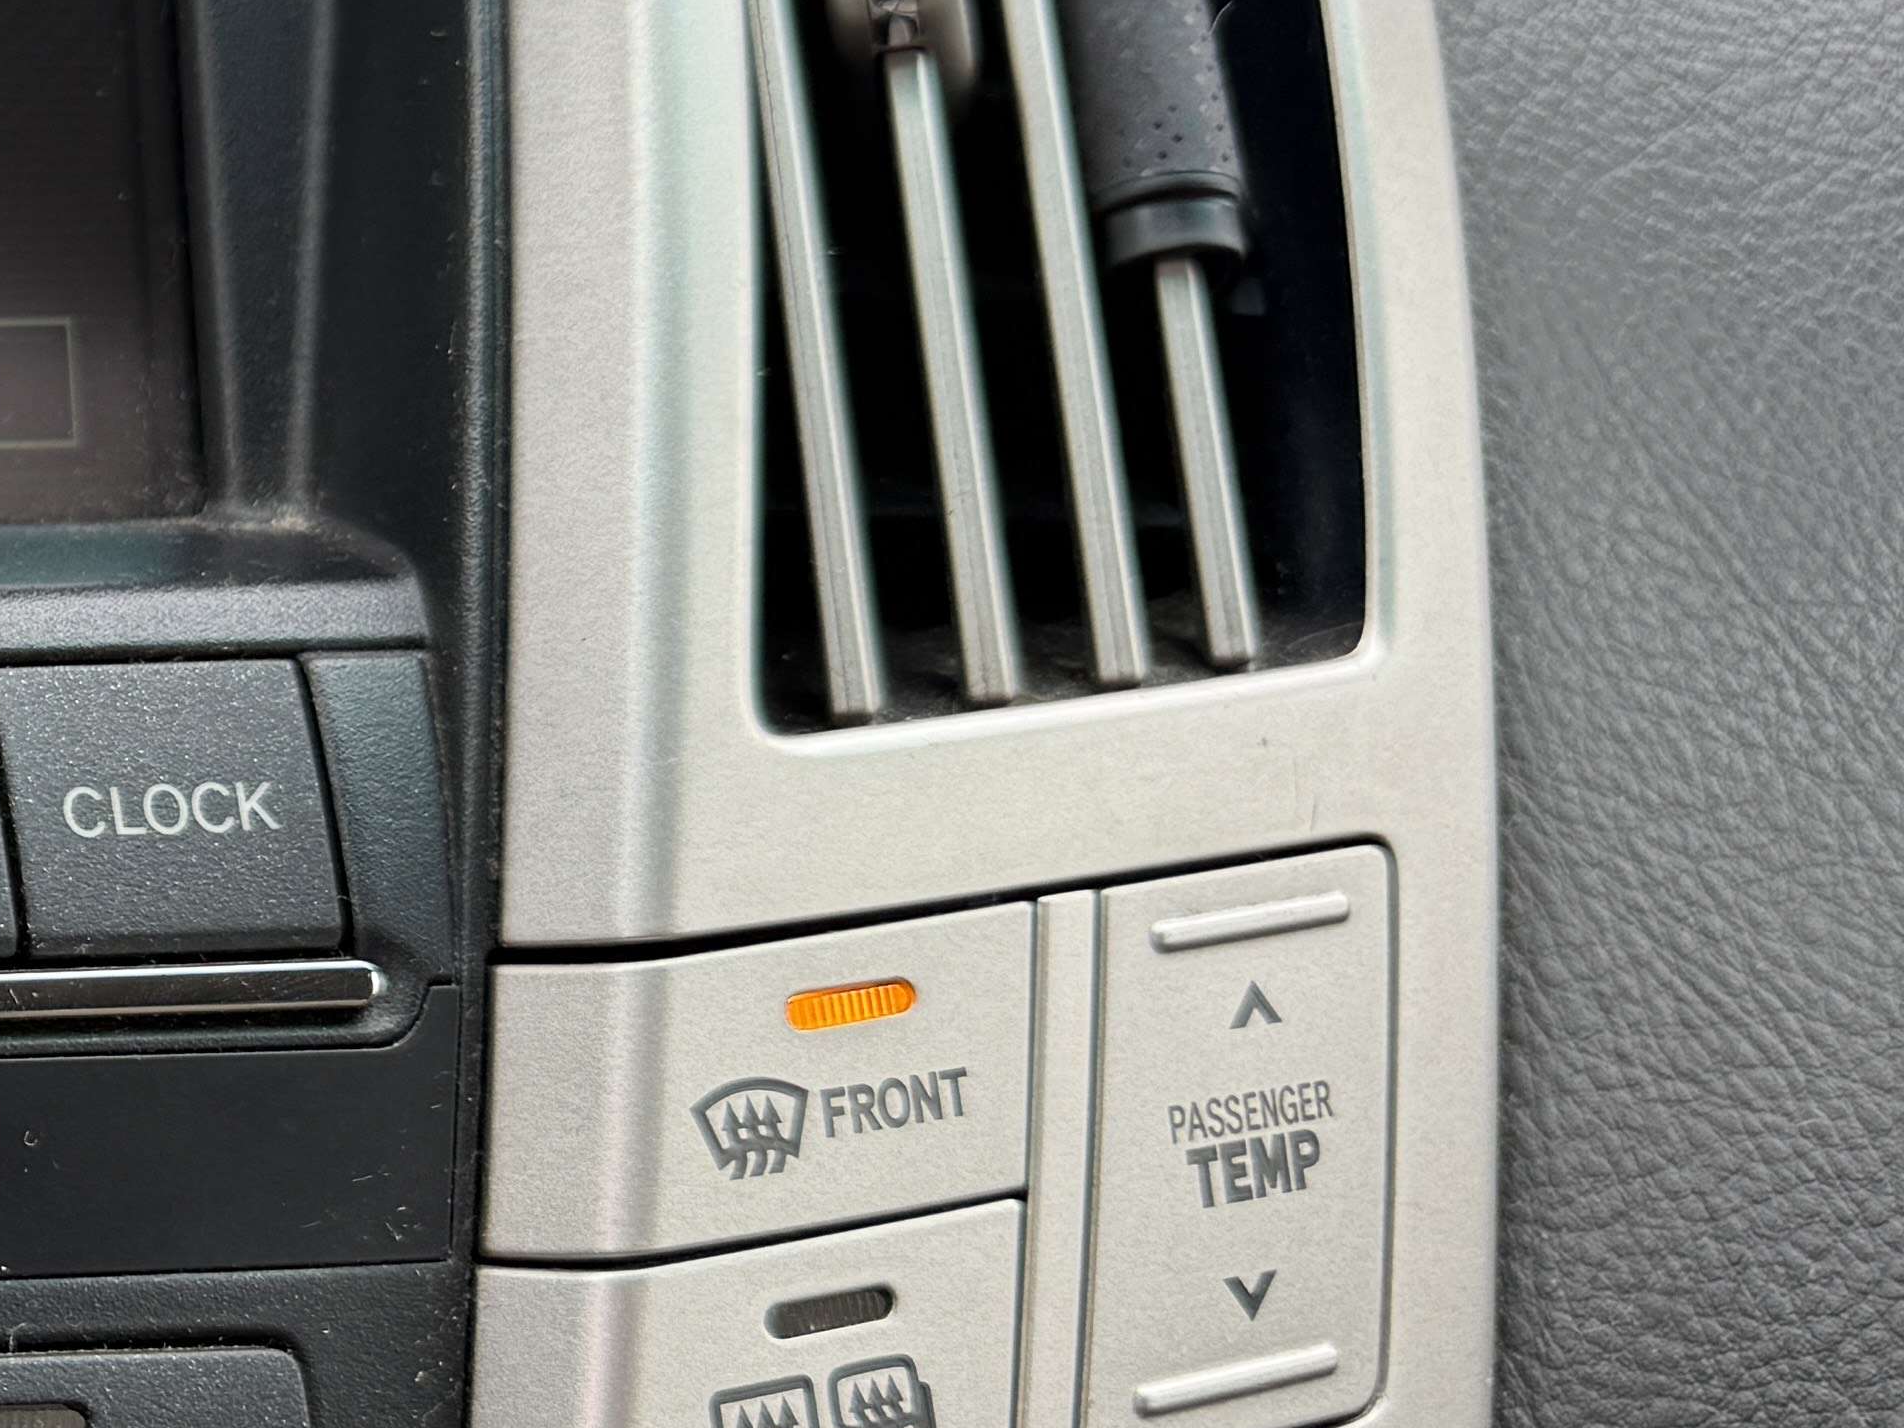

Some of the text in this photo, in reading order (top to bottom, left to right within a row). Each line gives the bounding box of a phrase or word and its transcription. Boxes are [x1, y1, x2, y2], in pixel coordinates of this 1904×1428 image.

[61, 779, 283, 840] CLOCK
[820, 1065, 969, 1140] FRONT
[1167, 1078, 1335, 1146] PASSENGER
[1185, 1128, 1321, 1210] TEMP
